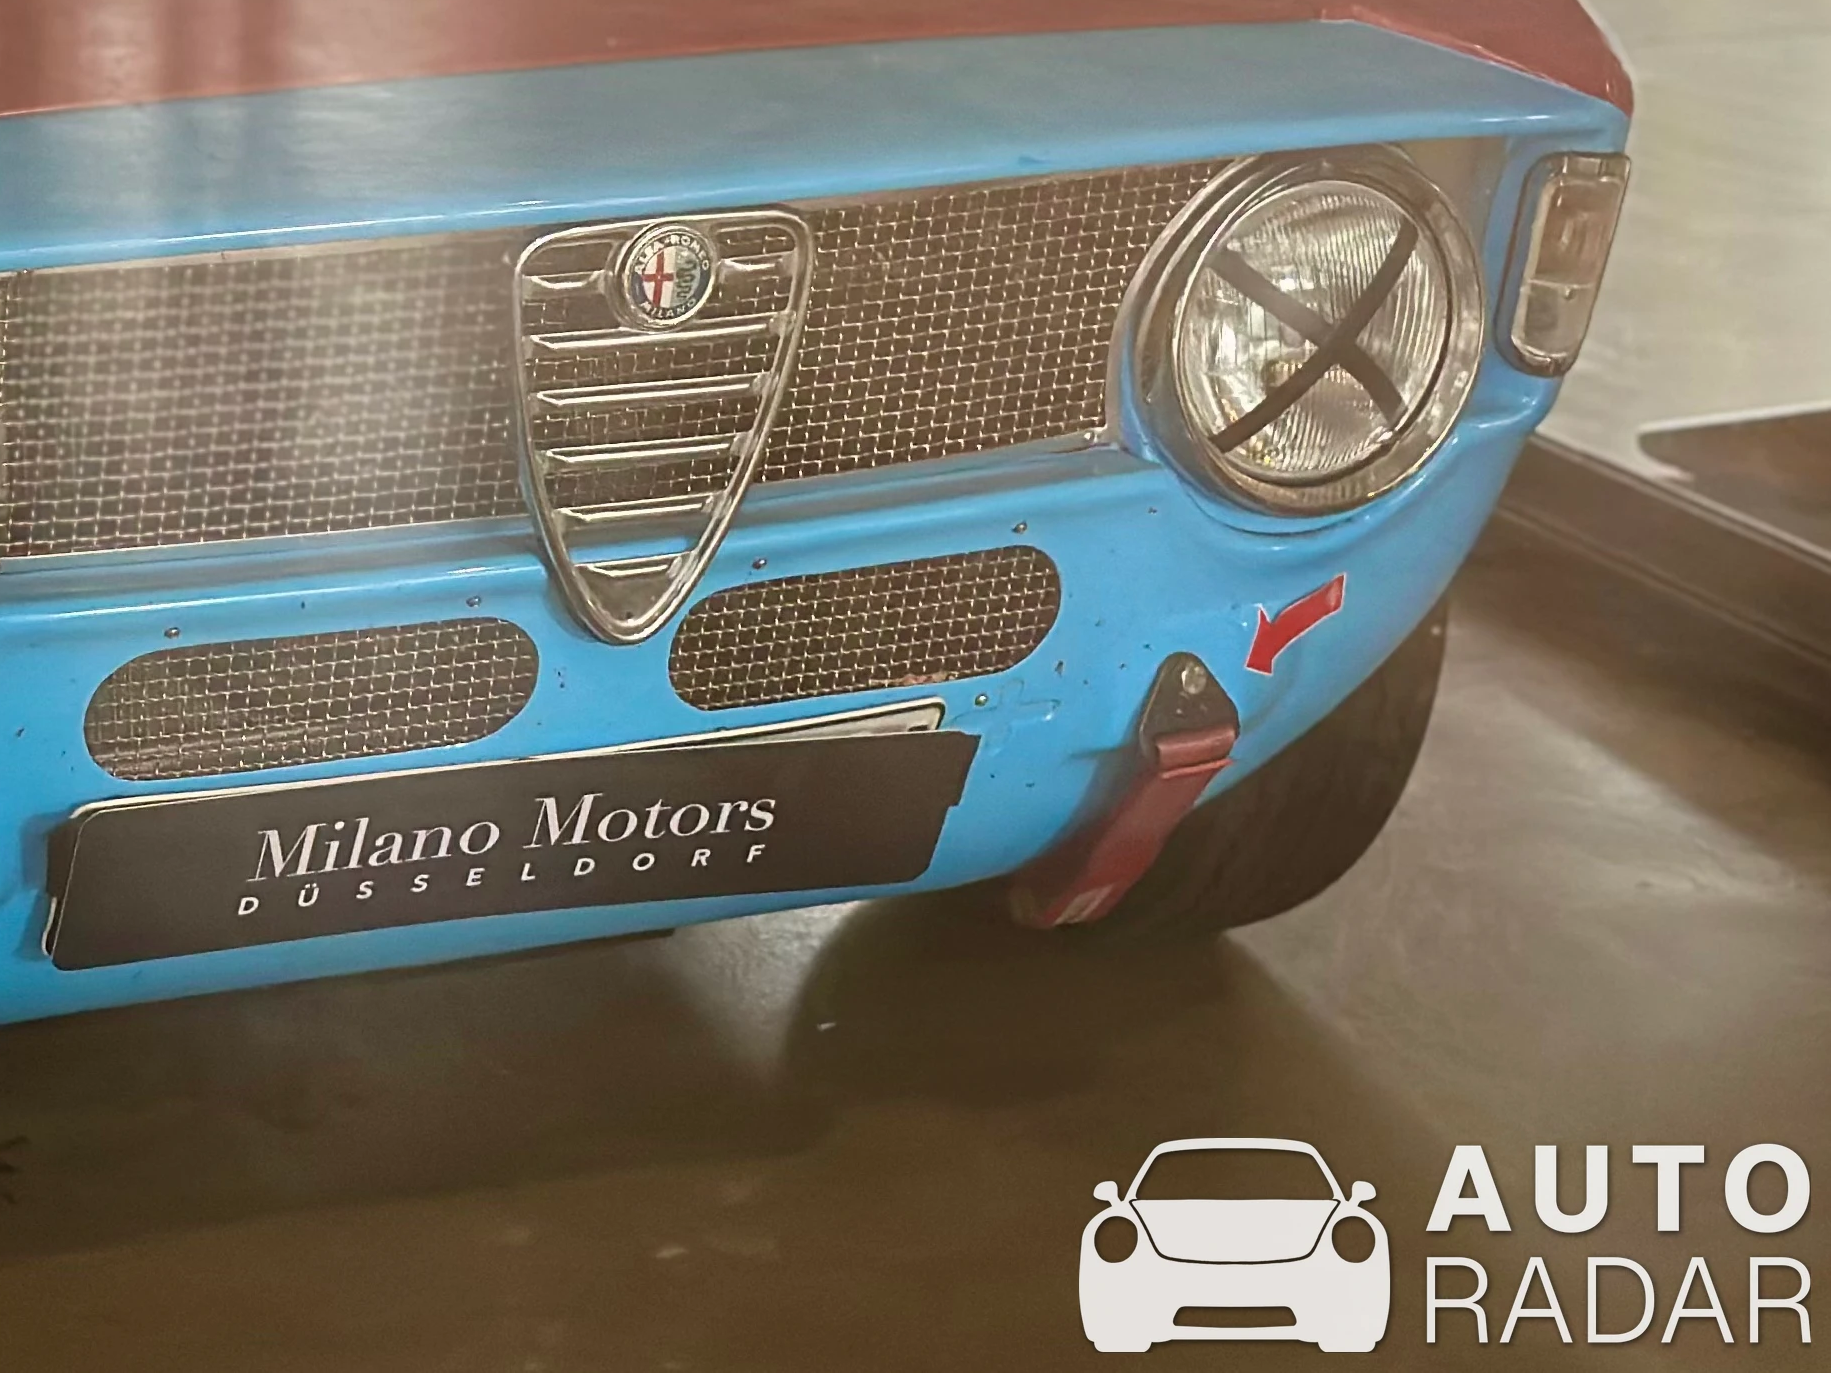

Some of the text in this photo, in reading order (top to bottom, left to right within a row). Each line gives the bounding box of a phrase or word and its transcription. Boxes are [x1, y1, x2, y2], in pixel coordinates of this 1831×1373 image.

[247, 793, 776, 884] Milano Motors
[237, 844, 767, 916] DÜSSELDORF
